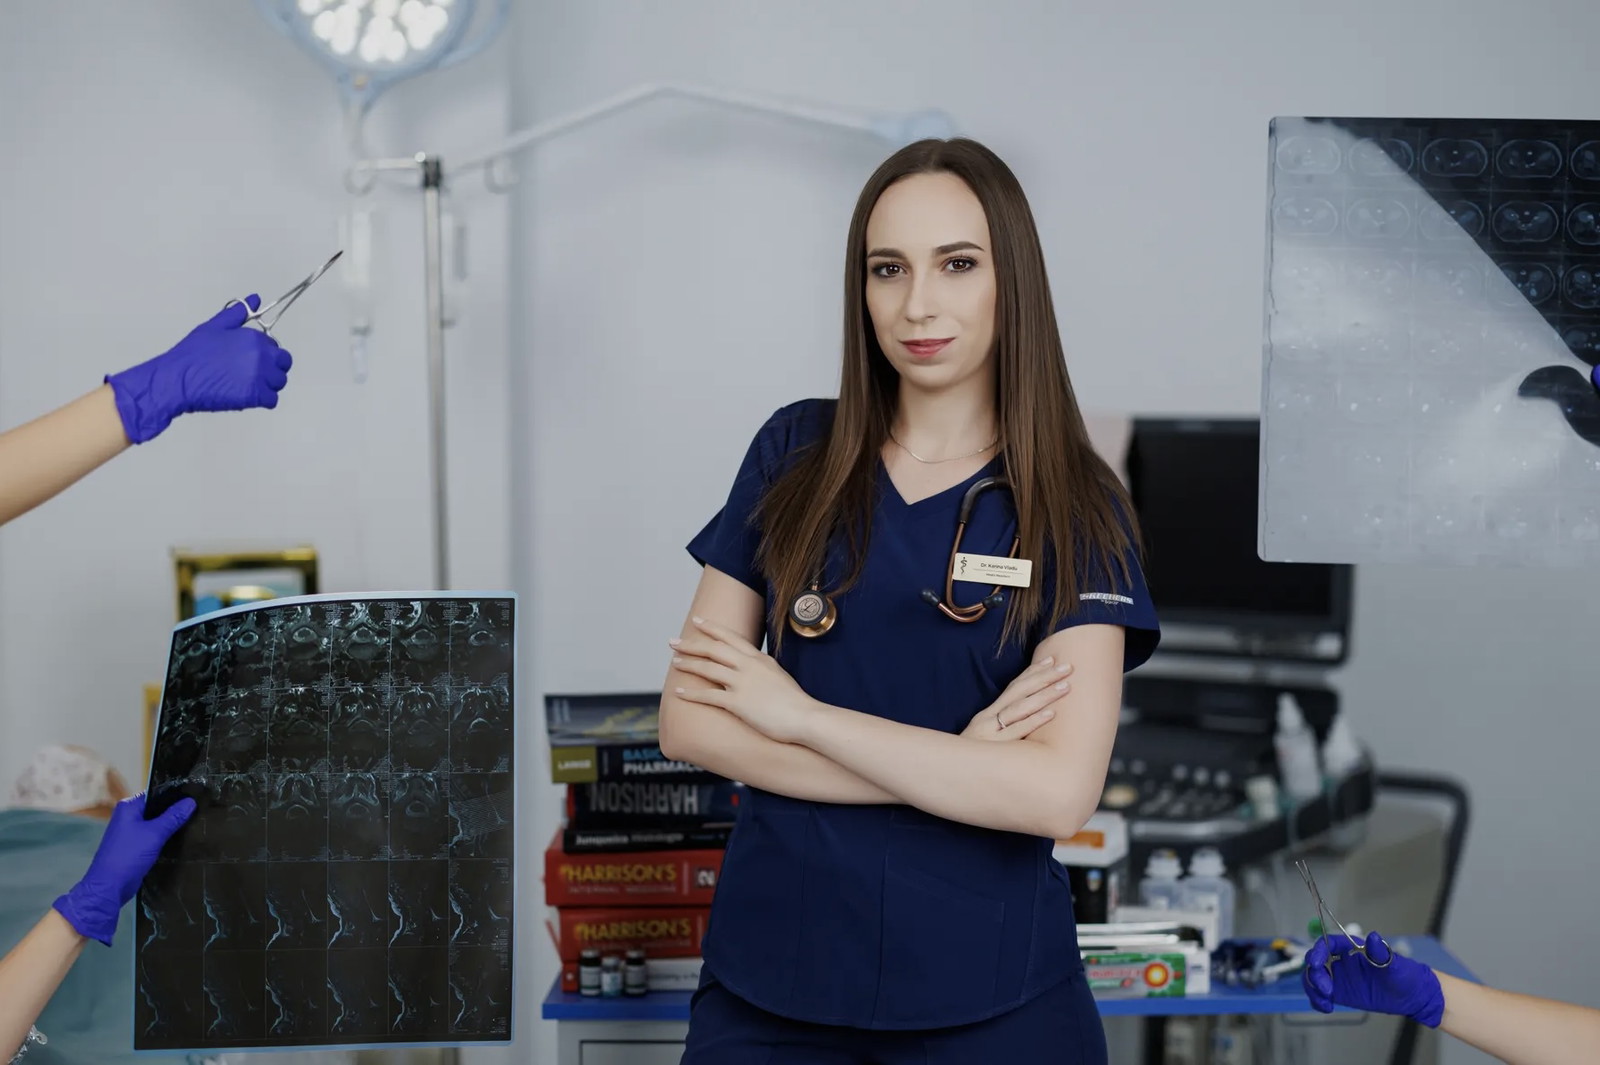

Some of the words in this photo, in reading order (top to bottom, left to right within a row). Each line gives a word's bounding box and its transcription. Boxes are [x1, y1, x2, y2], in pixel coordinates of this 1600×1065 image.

[590, 783, 698, 815] HARRISON
[561, 863, 677, 882] HARRISON'S
[575, 917, 691, 940] HARRISON'S
